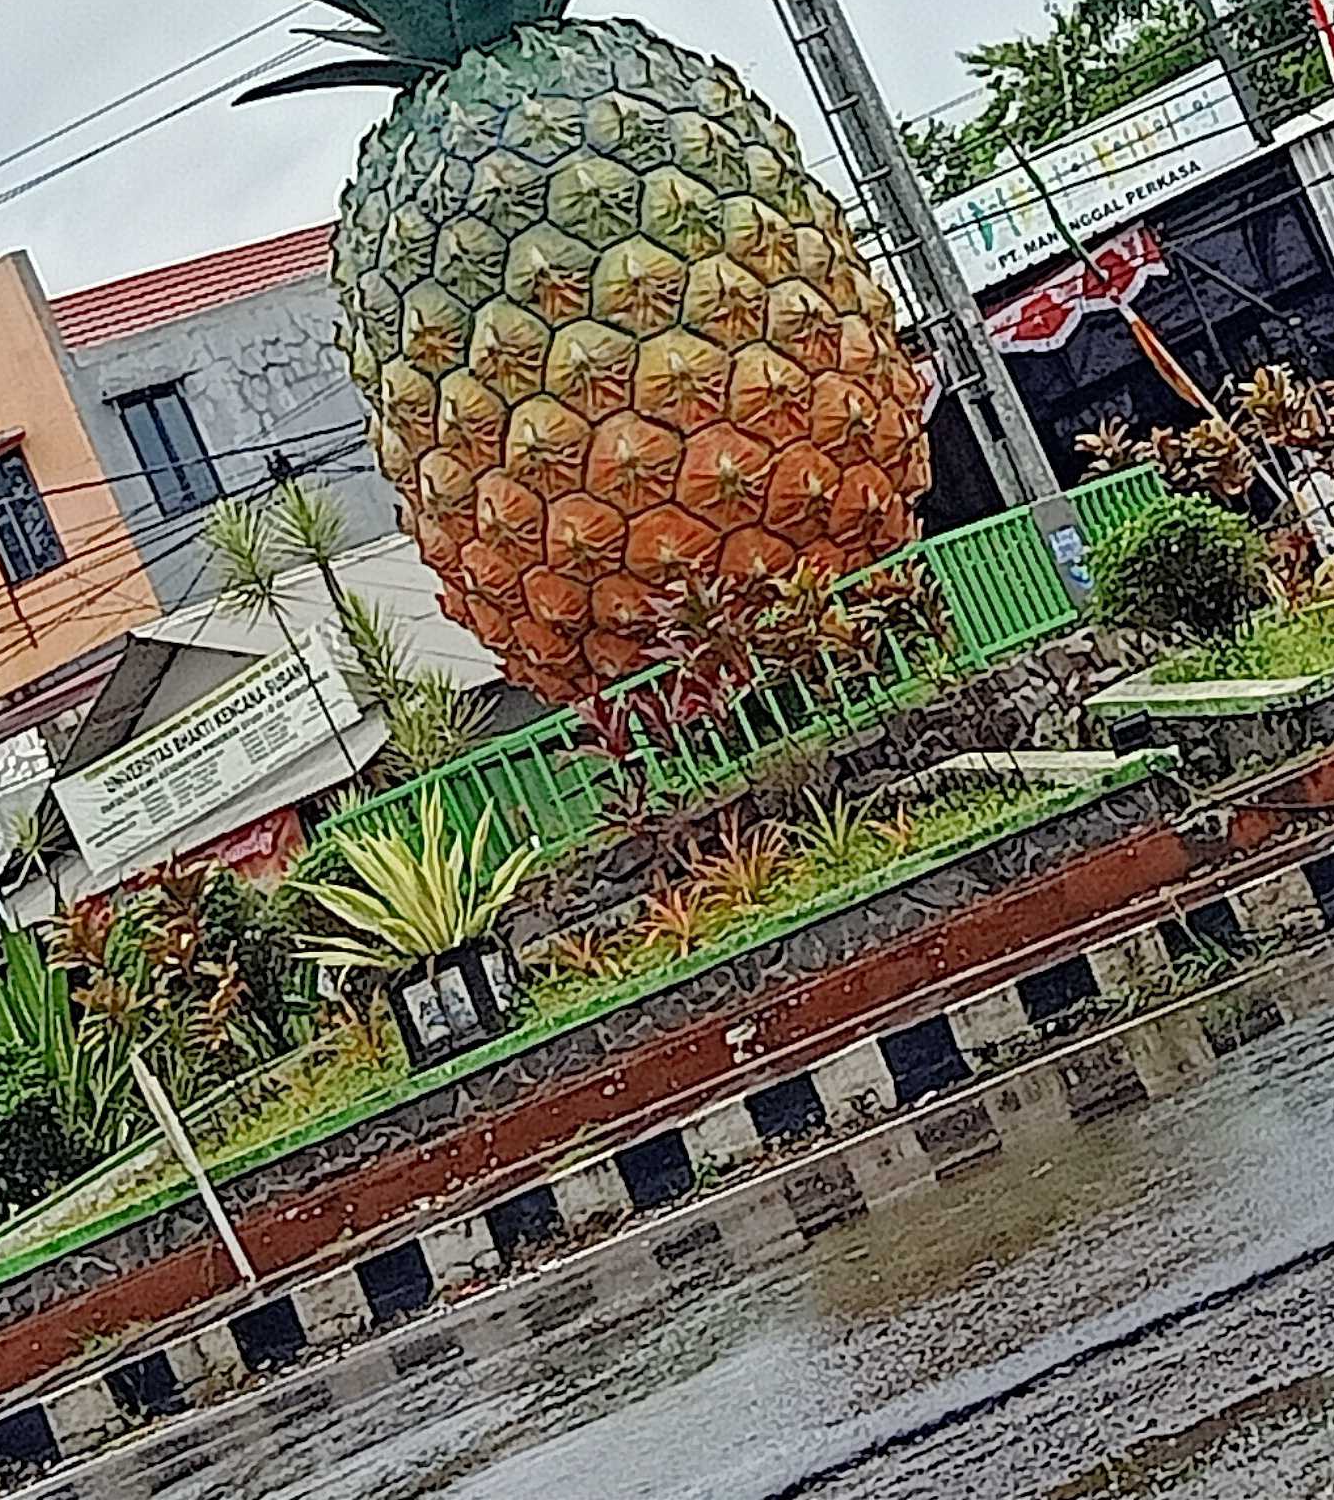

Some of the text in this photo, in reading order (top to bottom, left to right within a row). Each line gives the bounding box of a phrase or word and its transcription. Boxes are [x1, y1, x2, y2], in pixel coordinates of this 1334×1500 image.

[997, 250, 1022, 270] PT.
[1022, 199, 1123, 257] MANNGGAL
[1124, 158, 1203, 209] PERKASA
